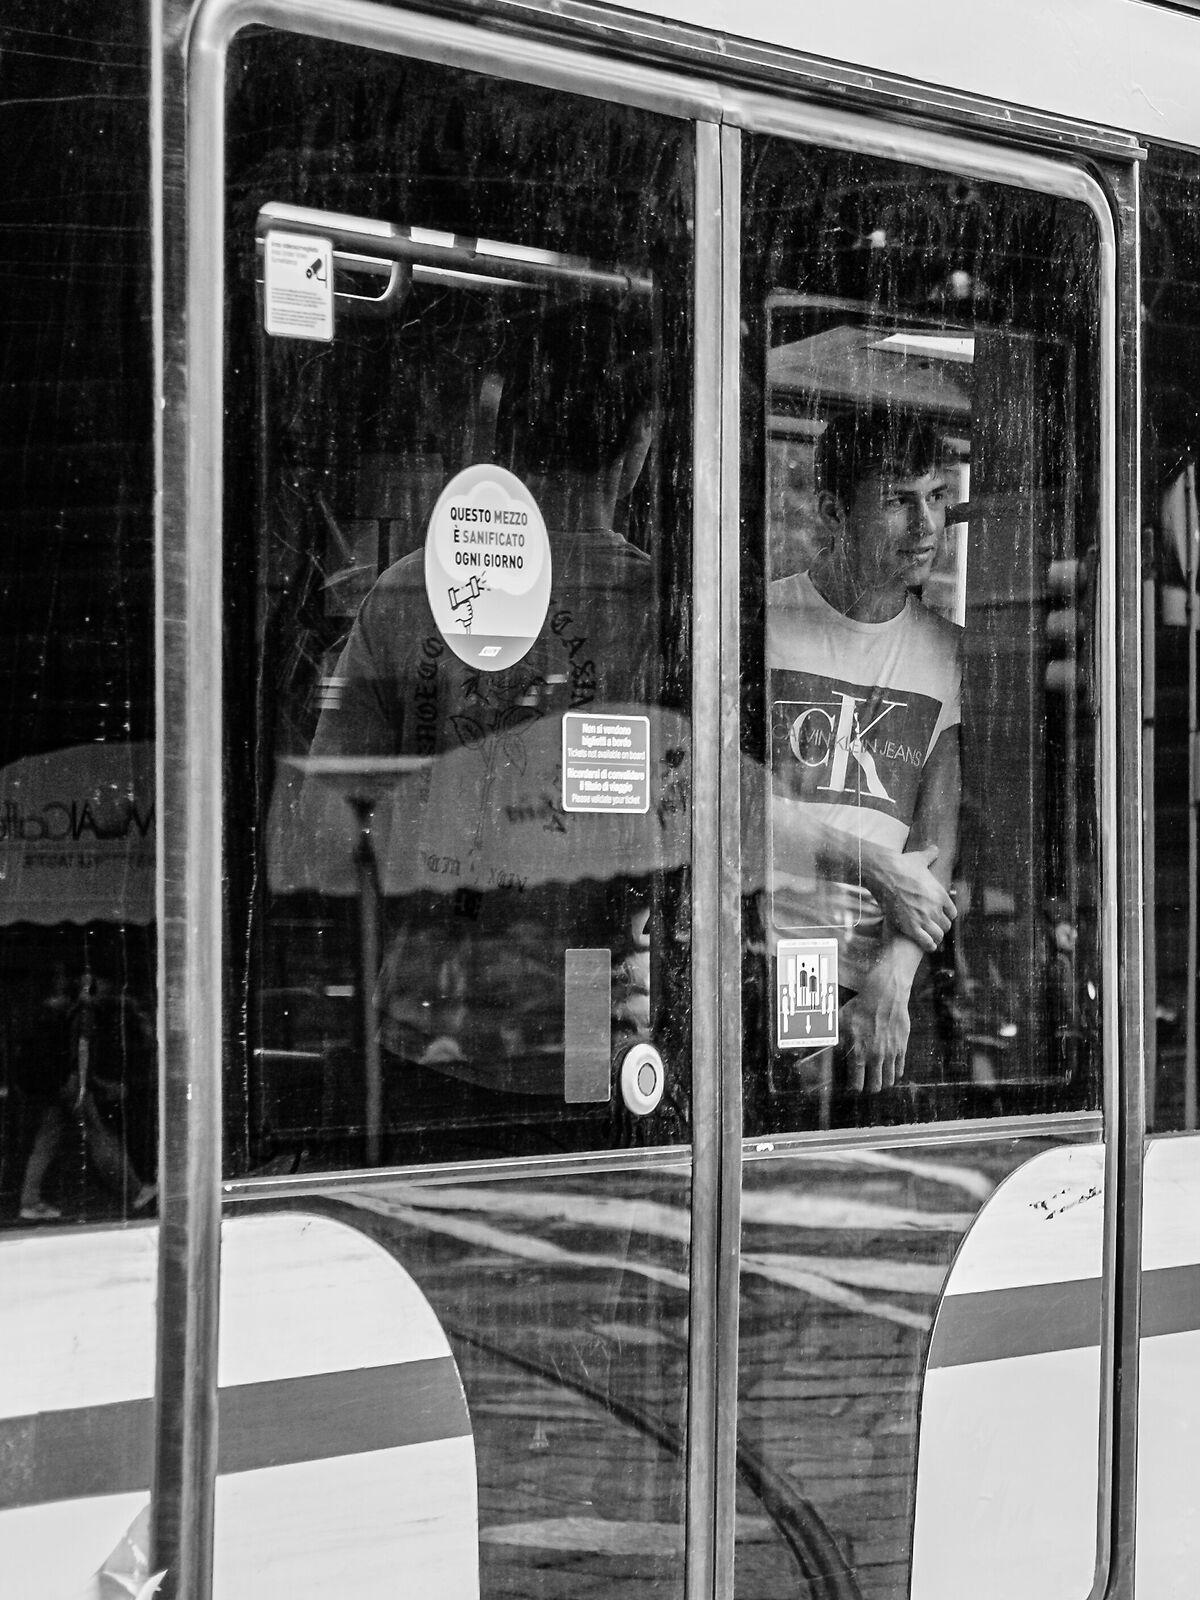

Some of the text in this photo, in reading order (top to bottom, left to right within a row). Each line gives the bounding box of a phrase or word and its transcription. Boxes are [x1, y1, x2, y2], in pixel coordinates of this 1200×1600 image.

[450, 506, 528, 526] QUESTO MEZZO
[453, 524, 525, 547] È SANIFICATO
[455, 551, 524, 569] OGNI GIORNO
[603, 725, 632, 735] vendono
[612, 737, 632, 748] bordo
[772, 723, 832, 749] CAVIN
[880, 739, 922, 767] JEANS
[609, 782, 633, 794] viaggio
[572, 793, 590, 803] Please
